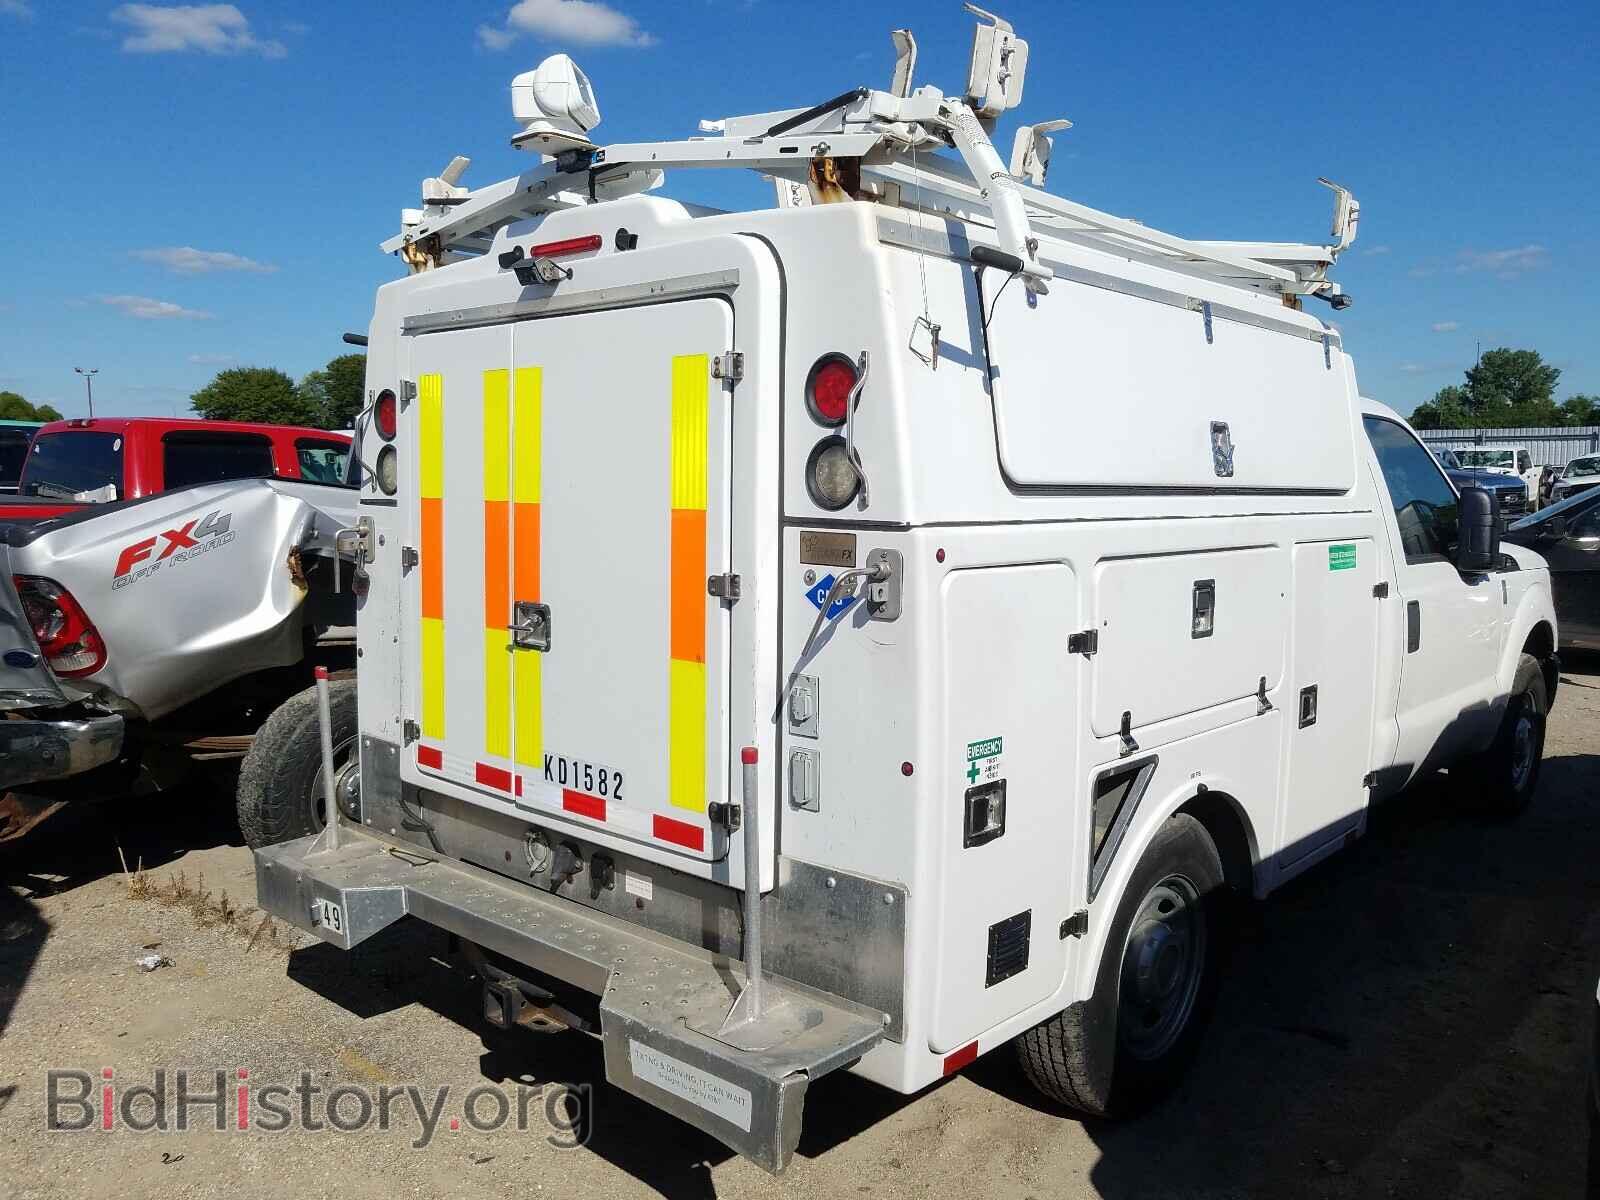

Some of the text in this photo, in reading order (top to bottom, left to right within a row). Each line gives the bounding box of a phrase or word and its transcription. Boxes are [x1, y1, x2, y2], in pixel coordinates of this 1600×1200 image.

[112, 531, 235, 590] OFF ROAD
[114, 510, 232, 578] FX4
[817, 589, 842, 605] CG
[967, 740, 1002, 758] EMERGENCY
[544, 754, 623, 800] KD1582
[324, 902, 341, 930] 49
